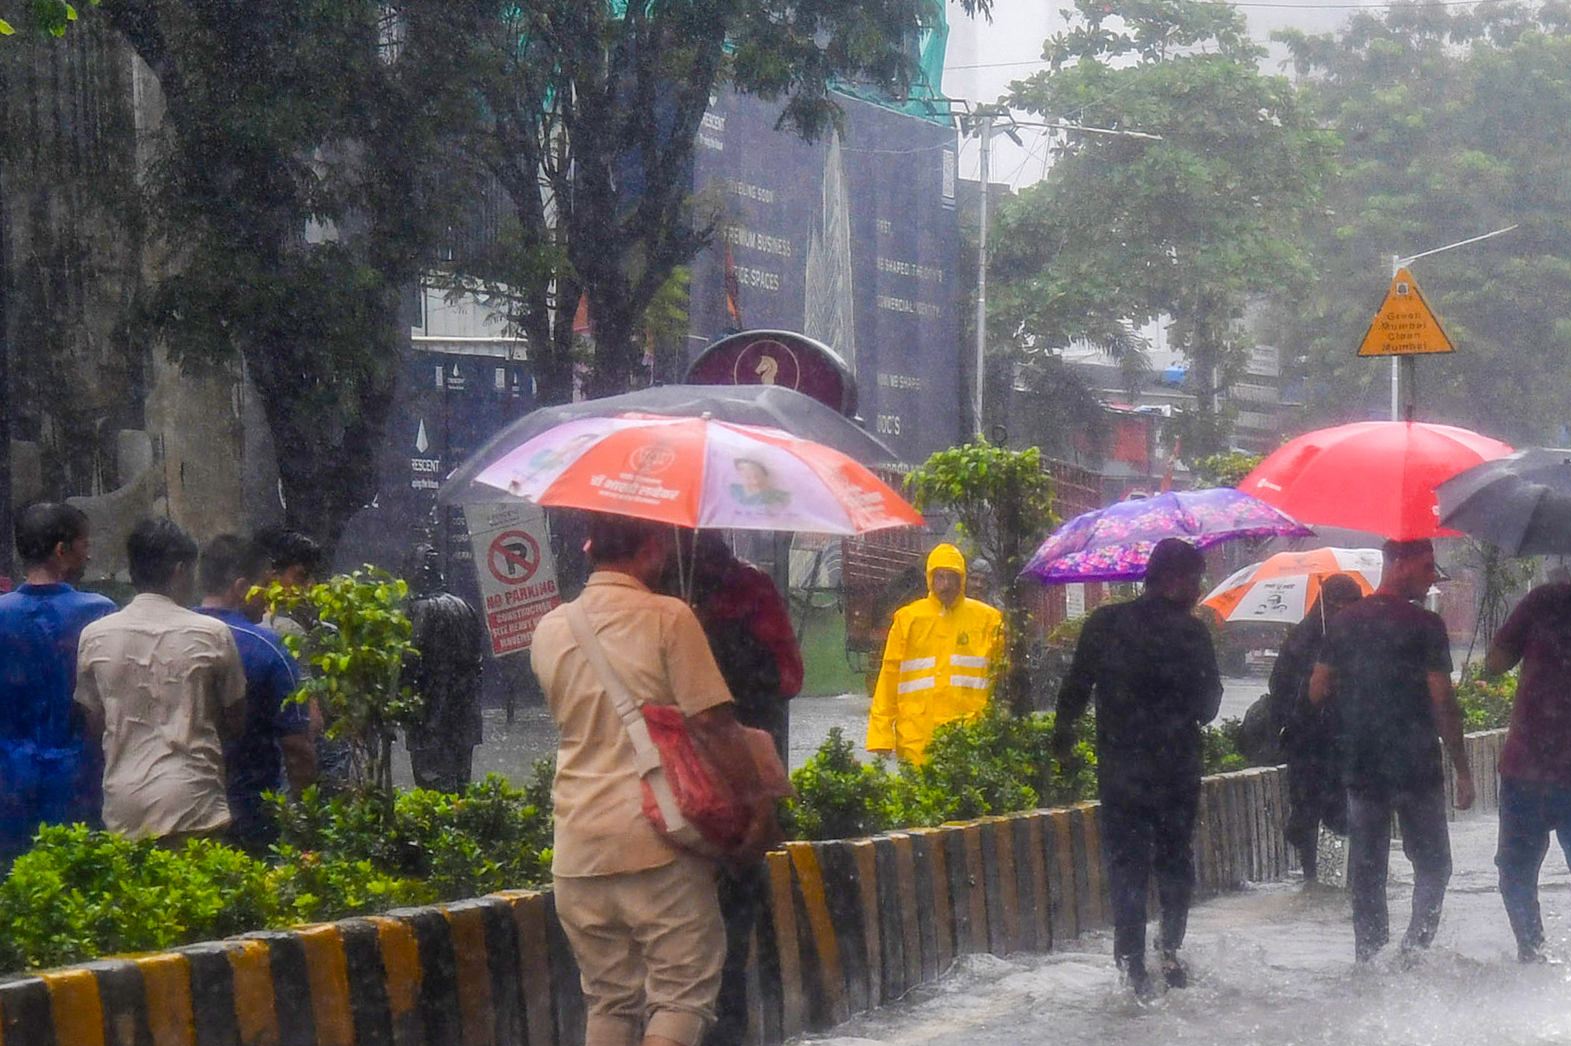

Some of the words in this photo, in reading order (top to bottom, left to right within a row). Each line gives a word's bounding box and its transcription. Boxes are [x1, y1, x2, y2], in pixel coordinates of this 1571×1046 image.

[757, 233, 792, 257] BUSINESS
[751, 269, 780, 290] SPACES
[1386, 312, 1421, 321] Green
[1381, 322, 1427, 331] Mumbai
[1387, 332, 1421, 341] Clean
[1381, 342, 1428, 352] Mumbai
[486, 594, 502, 610] NO
[505, 580, 556, 605] PARKING
